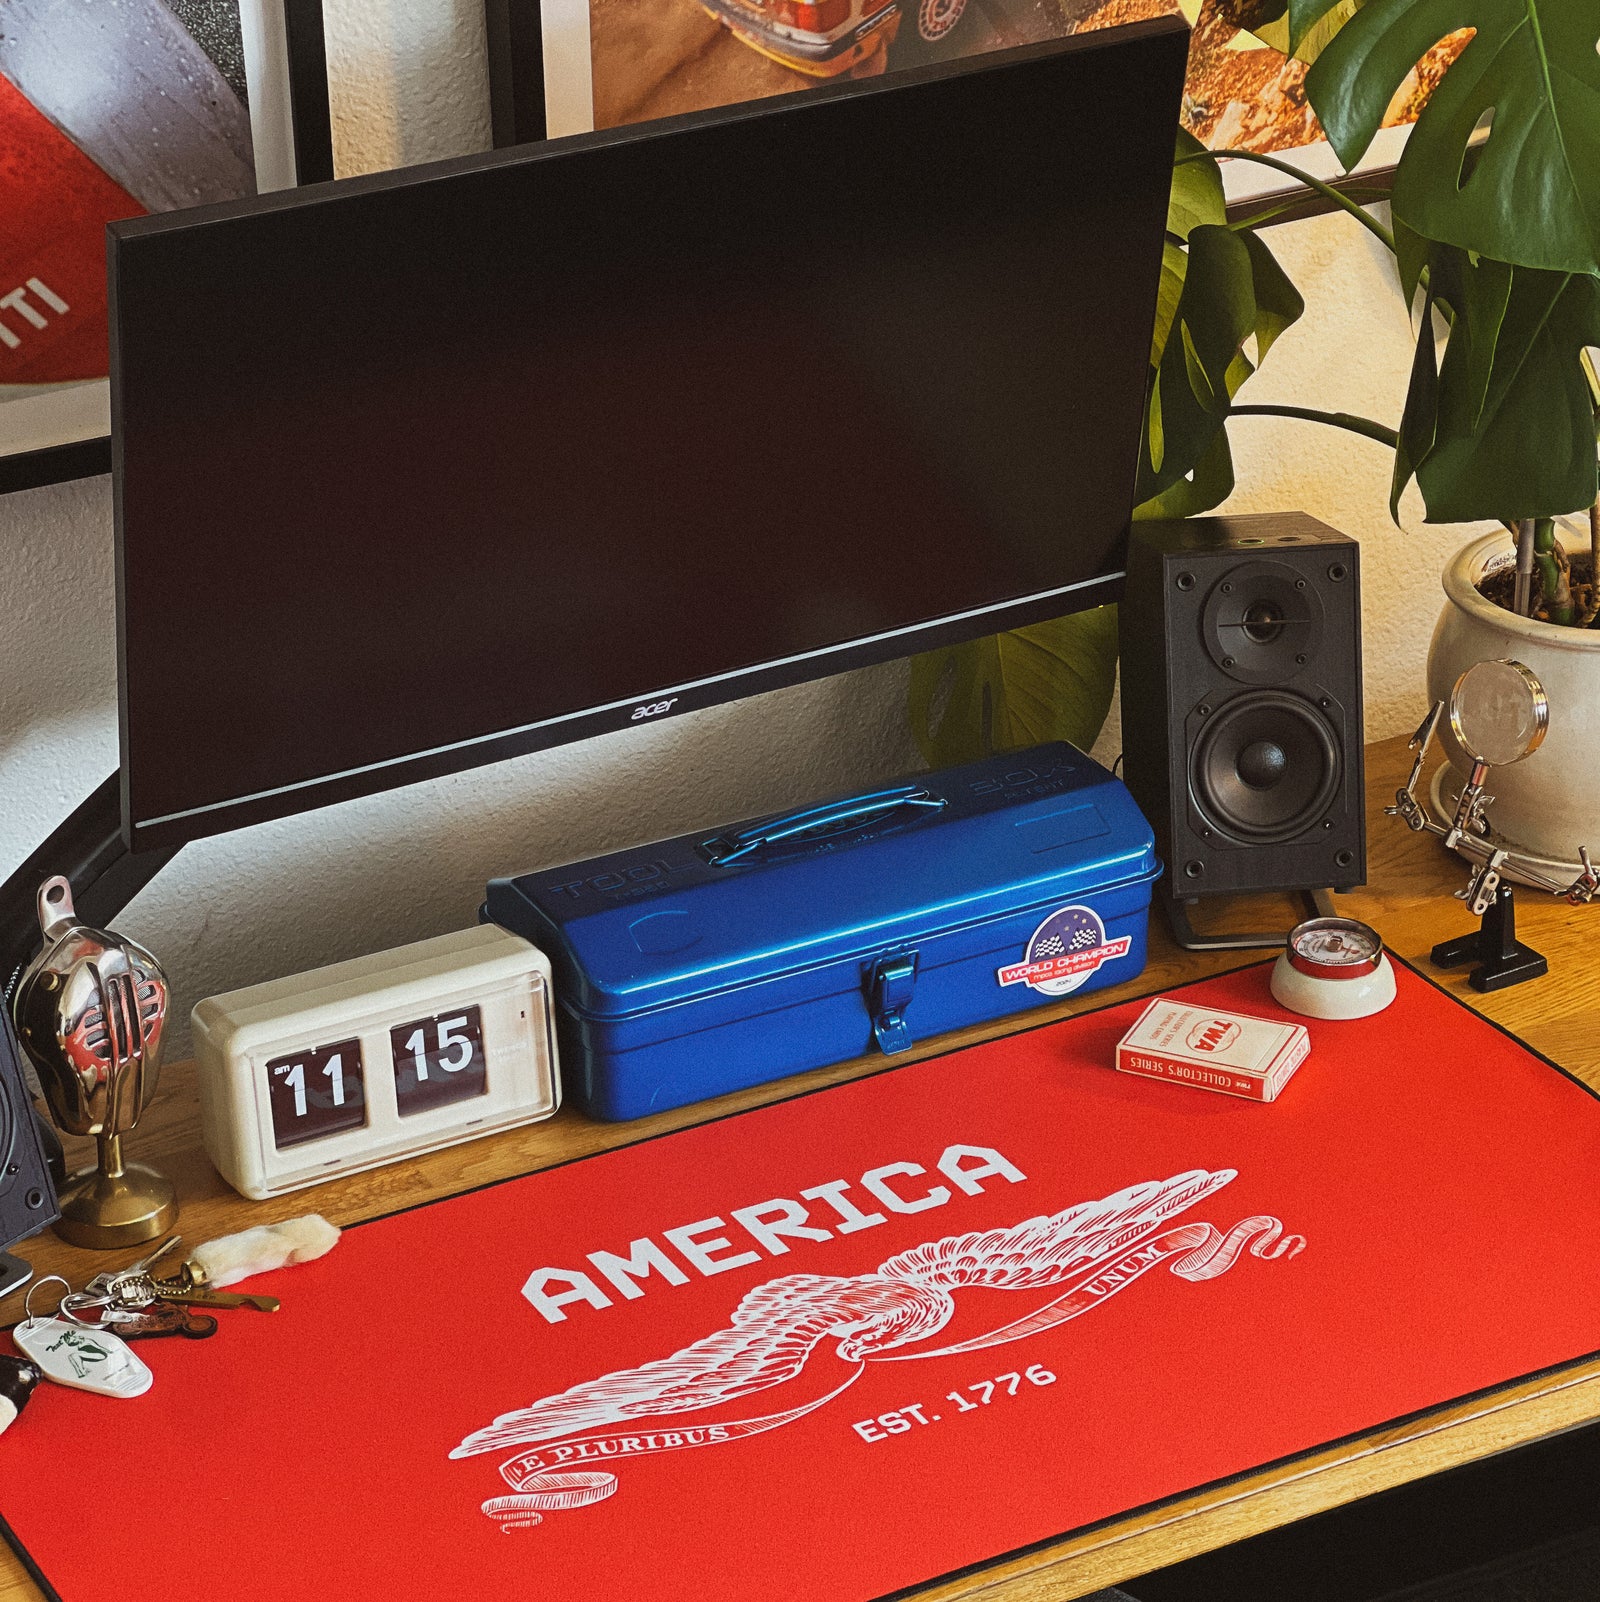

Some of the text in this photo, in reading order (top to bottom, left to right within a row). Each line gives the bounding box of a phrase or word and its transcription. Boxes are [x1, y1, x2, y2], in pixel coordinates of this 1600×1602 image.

[631, 698, 679, 720] acer
[1006, 943, 1124, 980] WORLD CHAMPION
[1194, 1020, 1234, 1052] TWA
[274, 1064, 291, 1076] am
[284, 1016, 473, 1117] 11 15
[1130, 1057, 1164, 1073] SERIES
[1168, 1065, 1232, 1088] COLLECTOR'S
[521, 1144, 1028, 1324] AMERICA
[519, 1243, 1169, 1474] E PLURIBUS UNUM
[851, 1363, 1057, 1444] EST. 1776
